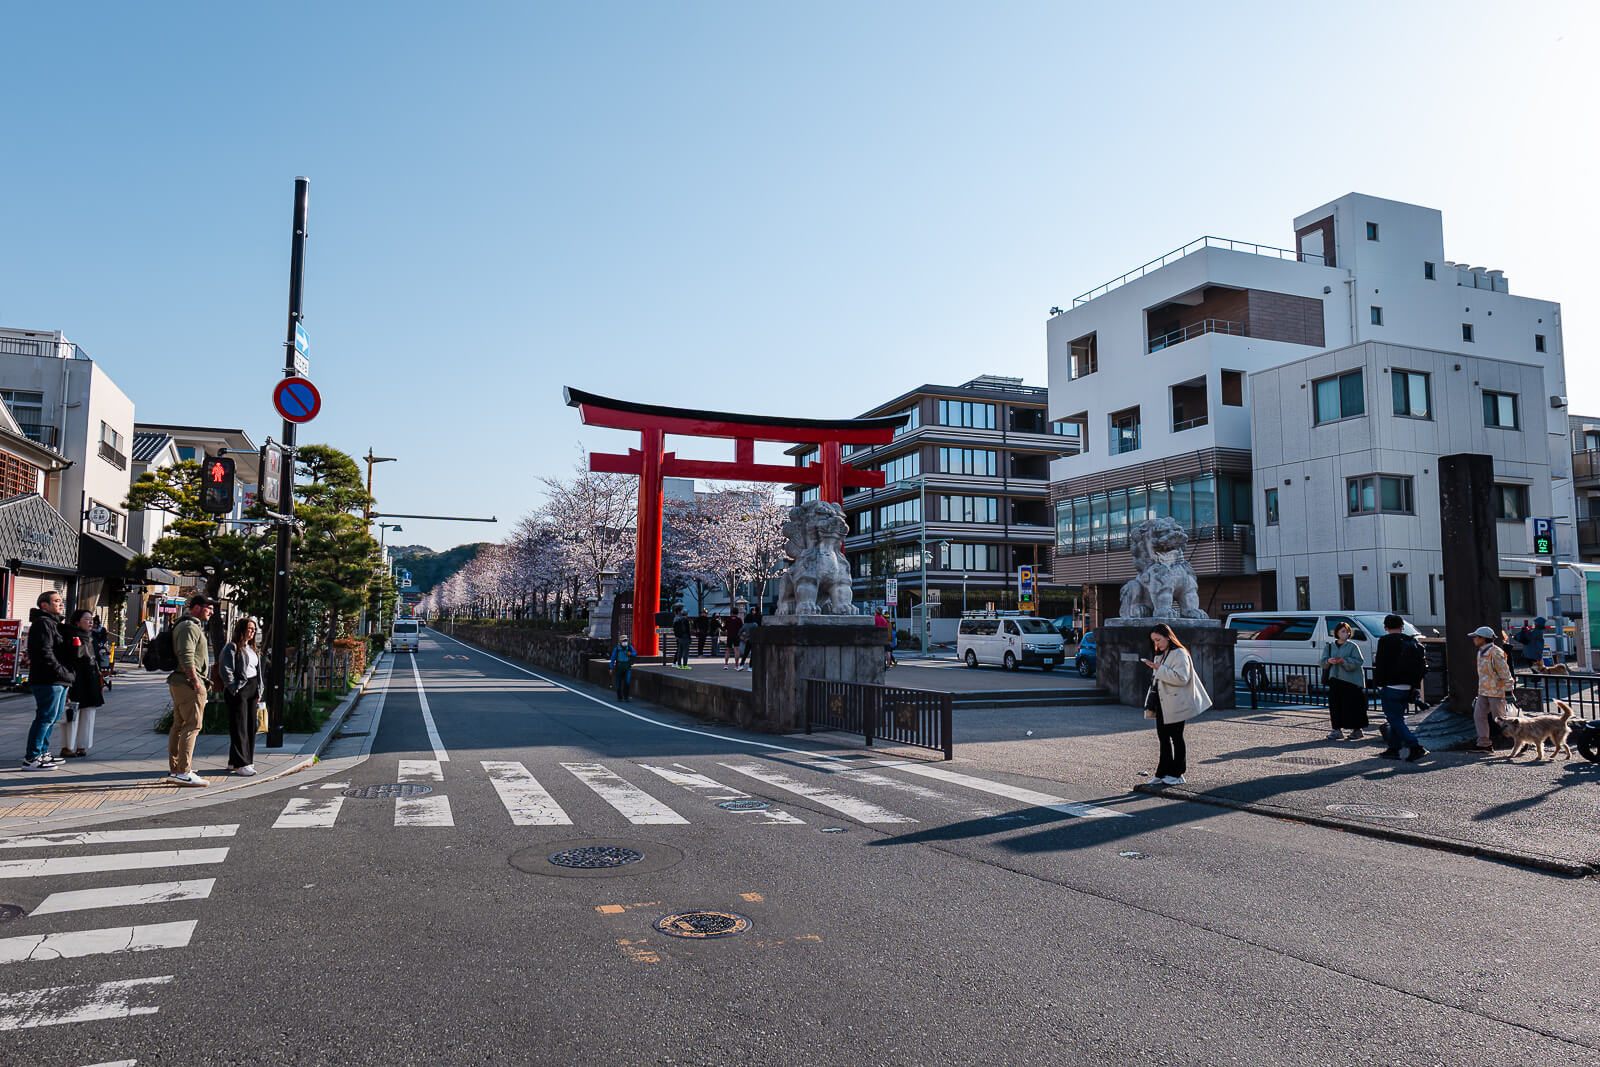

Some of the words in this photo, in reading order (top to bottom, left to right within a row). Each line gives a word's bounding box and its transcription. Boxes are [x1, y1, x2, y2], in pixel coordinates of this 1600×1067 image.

[1538, 520, 1548, 535] P
[1537, 538, 1549, 553] 空
[1022, 571, 1031, 583] P
